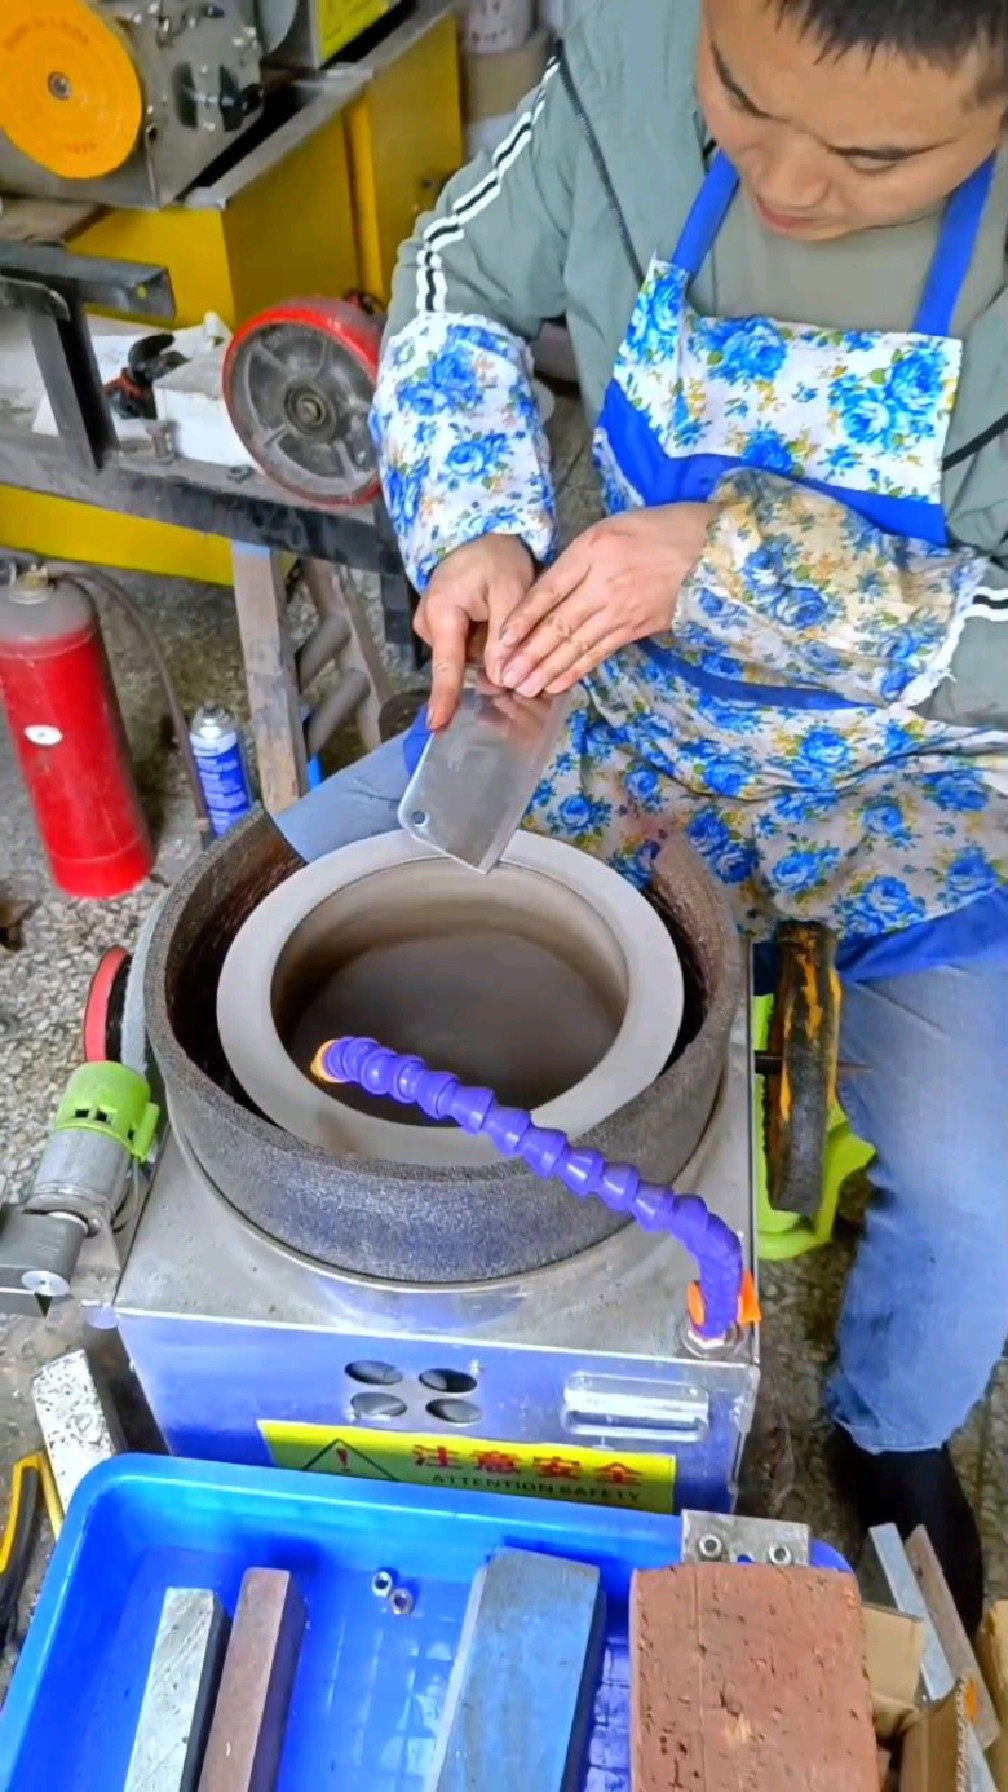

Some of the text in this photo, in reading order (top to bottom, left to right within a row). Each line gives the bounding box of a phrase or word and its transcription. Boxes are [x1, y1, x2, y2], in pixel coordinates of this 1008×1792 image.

[412, 1445, 643, 1487] 注意安全
[432, 1473, 640, 1501] ATTENTION SAFETY
